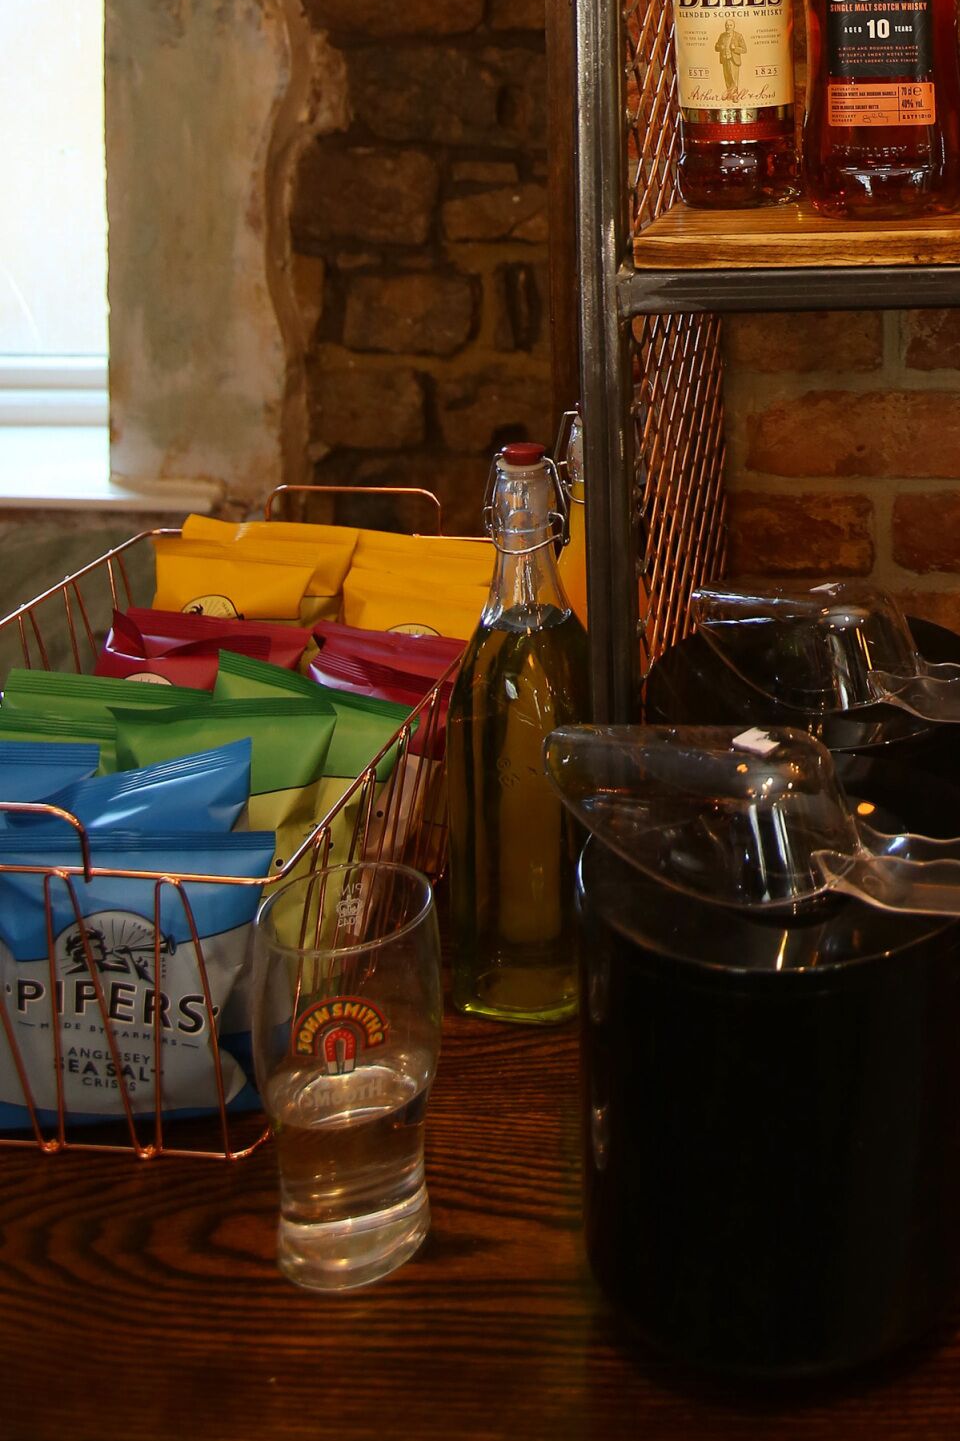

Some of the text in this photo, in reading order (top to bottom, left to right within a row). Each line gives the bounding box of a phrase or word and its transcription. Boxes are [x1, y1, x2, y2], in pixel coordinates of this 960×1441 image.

[679, 9, 783, 19] BLENDED SCOTCH WHISKY
[830, 2, 927, 12] SINGLE MALT SCOTCH WHISKY
[866, 19, 890, 39] 10
[755, 67, 778, 76] 1825
[16, 978, 208, 1035] PIPERS
[40, 1022, 179, 1047] MDE BY FARMRS
[298, 1006, 331, 1054] JOHN
[82, 1076, 137, 1092] CRISS
[306, 1078, 384, 1107] SMOOTH
